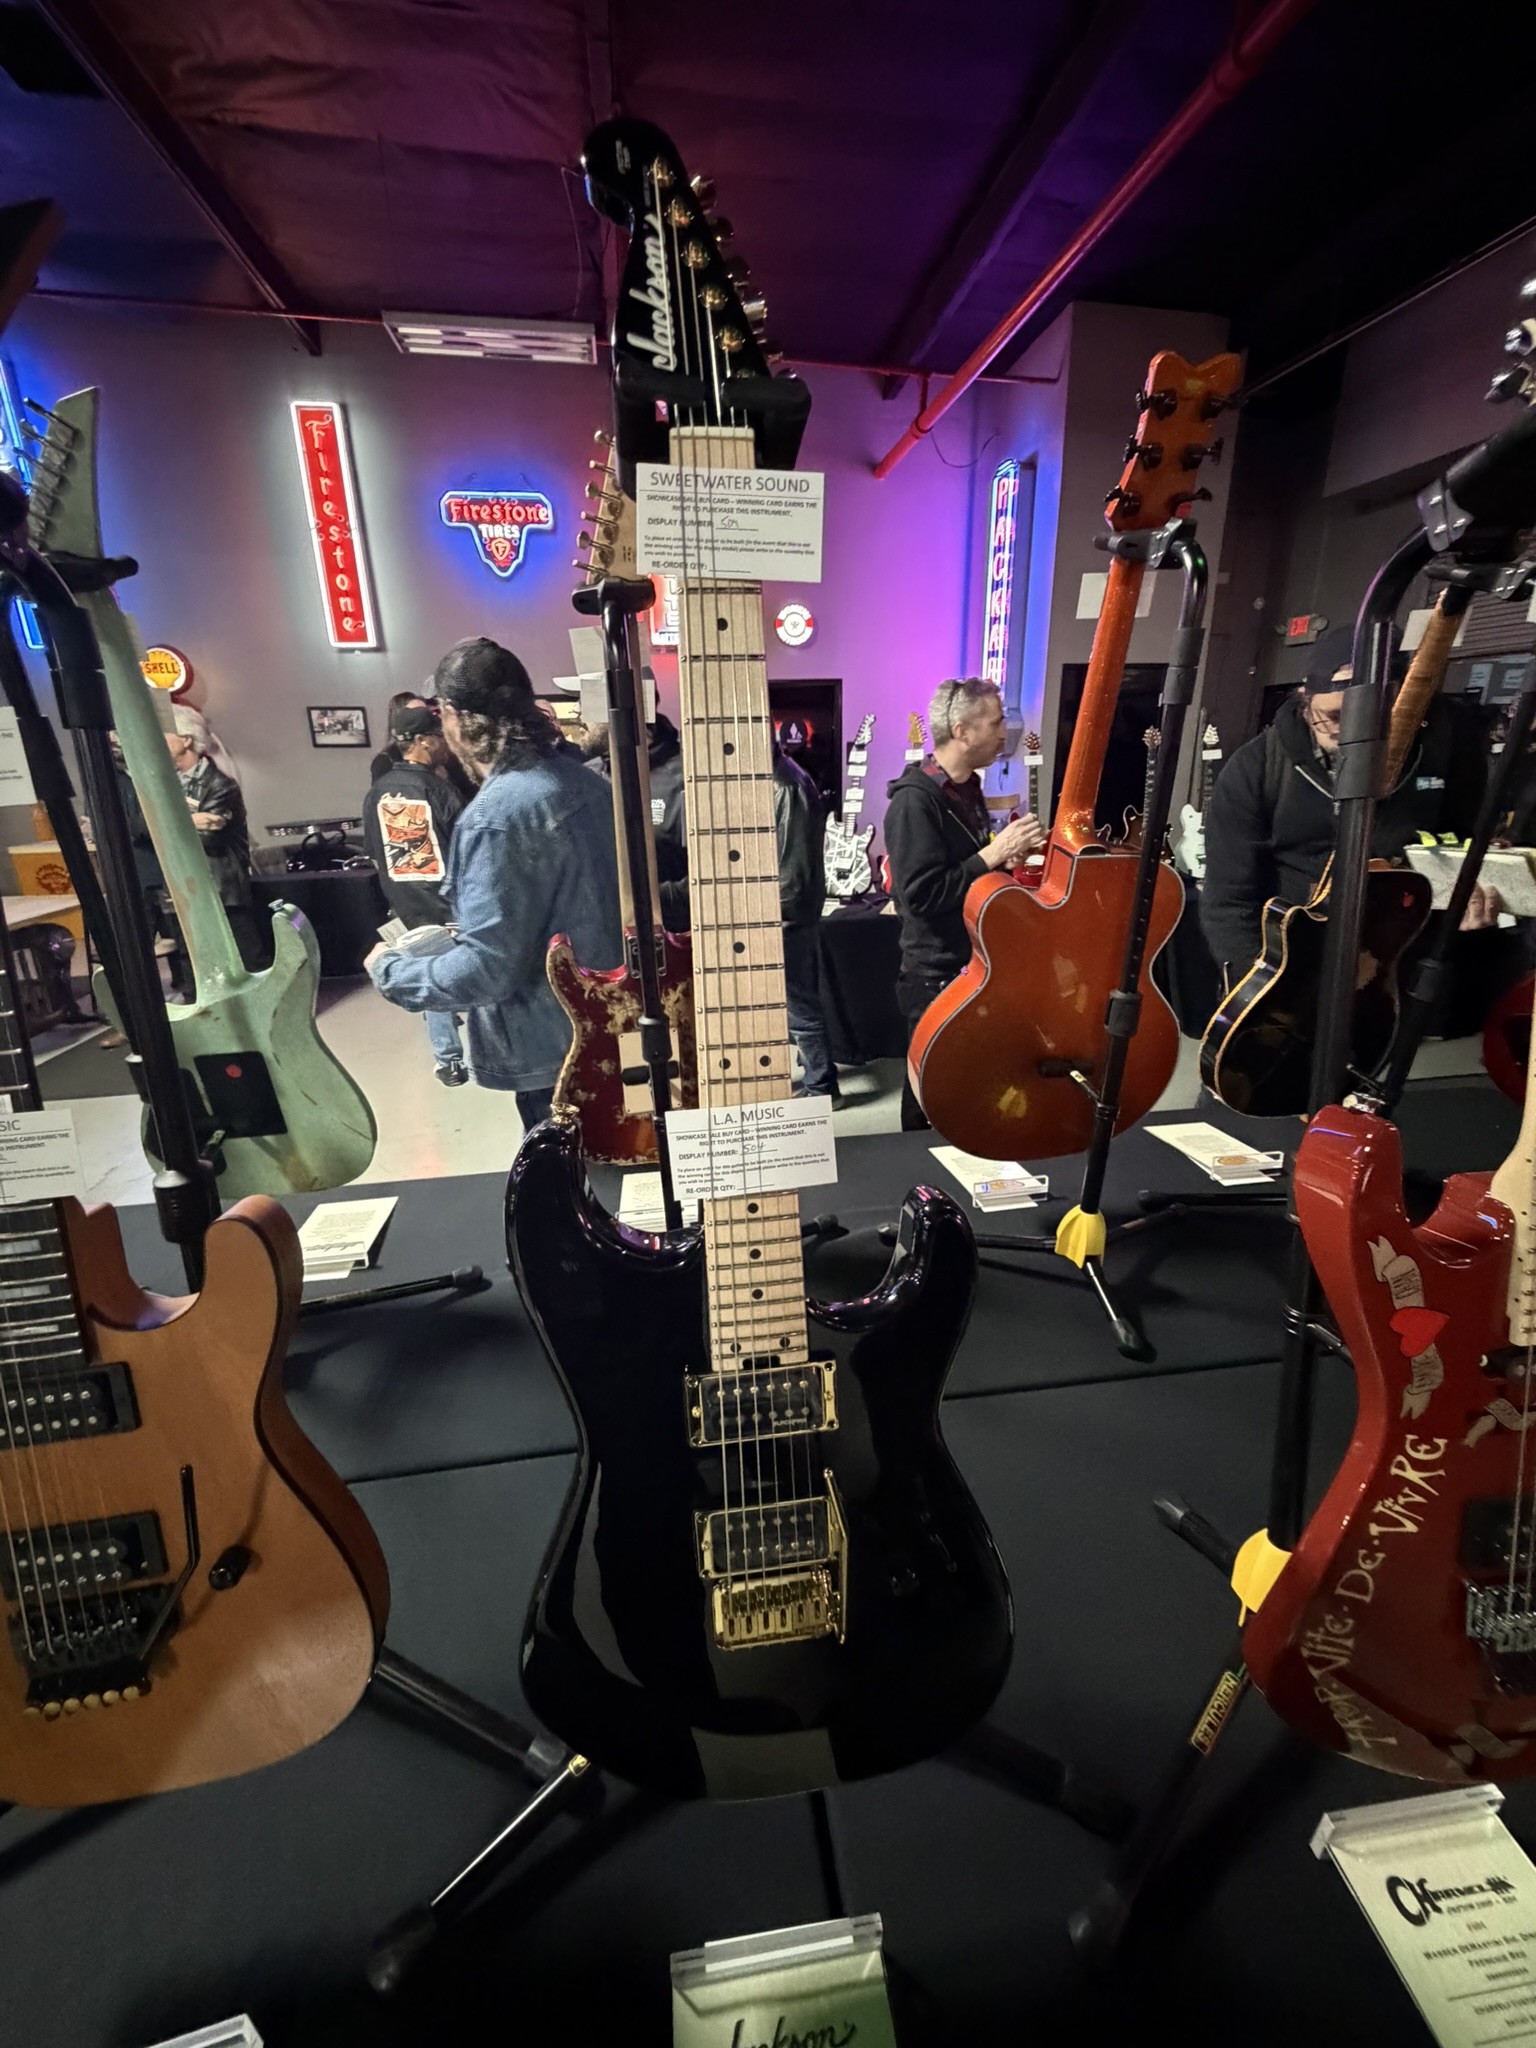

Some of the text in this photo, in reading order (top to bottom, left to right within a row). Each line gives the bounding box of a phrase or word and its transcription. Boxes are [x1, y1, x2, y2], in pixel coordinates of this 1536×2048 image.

[627, 212, 677, 372] Jackson
[650, 472, 810, 493] SWEETWATER SOUND
[445, 496, 549, 522] Firestone
[304, 413, 366, 633] Firestone
[648, 518, 677, 527] DISPLAY
[478, 524, 521, 539] TIRES
[145, 662, 179, 674] SHELL
[713, 1106, 785, 1126] L.A. MUSIC
[676, 1132, 707, 1141] SHOWCASE
[756, 1124, 781, 1133] WINNING
[769, 1131, 806, 1139] INSTRUMENT.
[679, 1152, 706, 1160] DISPLAY
[743, 1142, 766, 1154] 504
[686, 1184, 736, 1194] RE-ORDR QTY:
[1196, 1674, 1239, 1746] HERCULES
